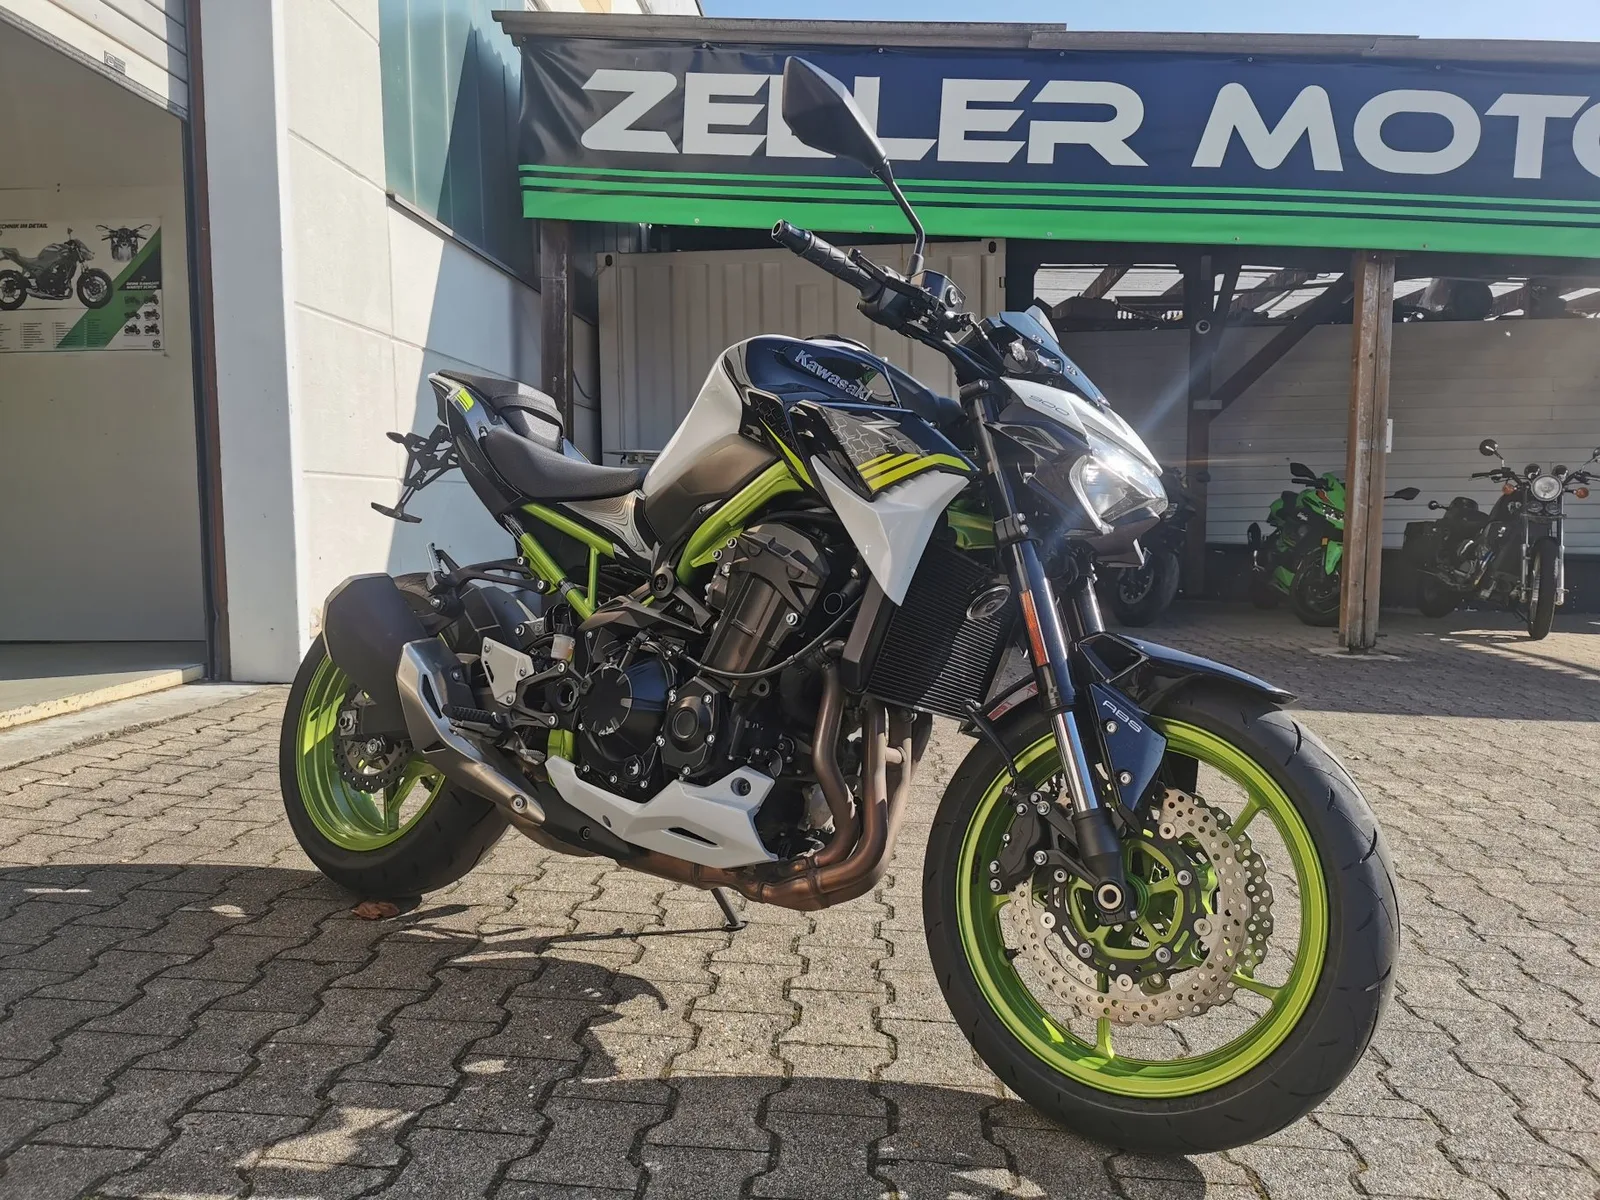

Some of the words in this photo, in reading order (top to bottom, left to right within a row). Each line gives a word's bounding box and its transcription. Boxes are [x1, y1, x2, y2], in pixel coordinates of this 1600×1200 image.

[580, 68, 1149, 167] ZELLER
[1191, 82, 1600, 180] MOT
[794, 349, 874, 402] Kawasaki
[1028, 394, 1070, 417] 900
[1102, 700, 1143, 733] ABS
